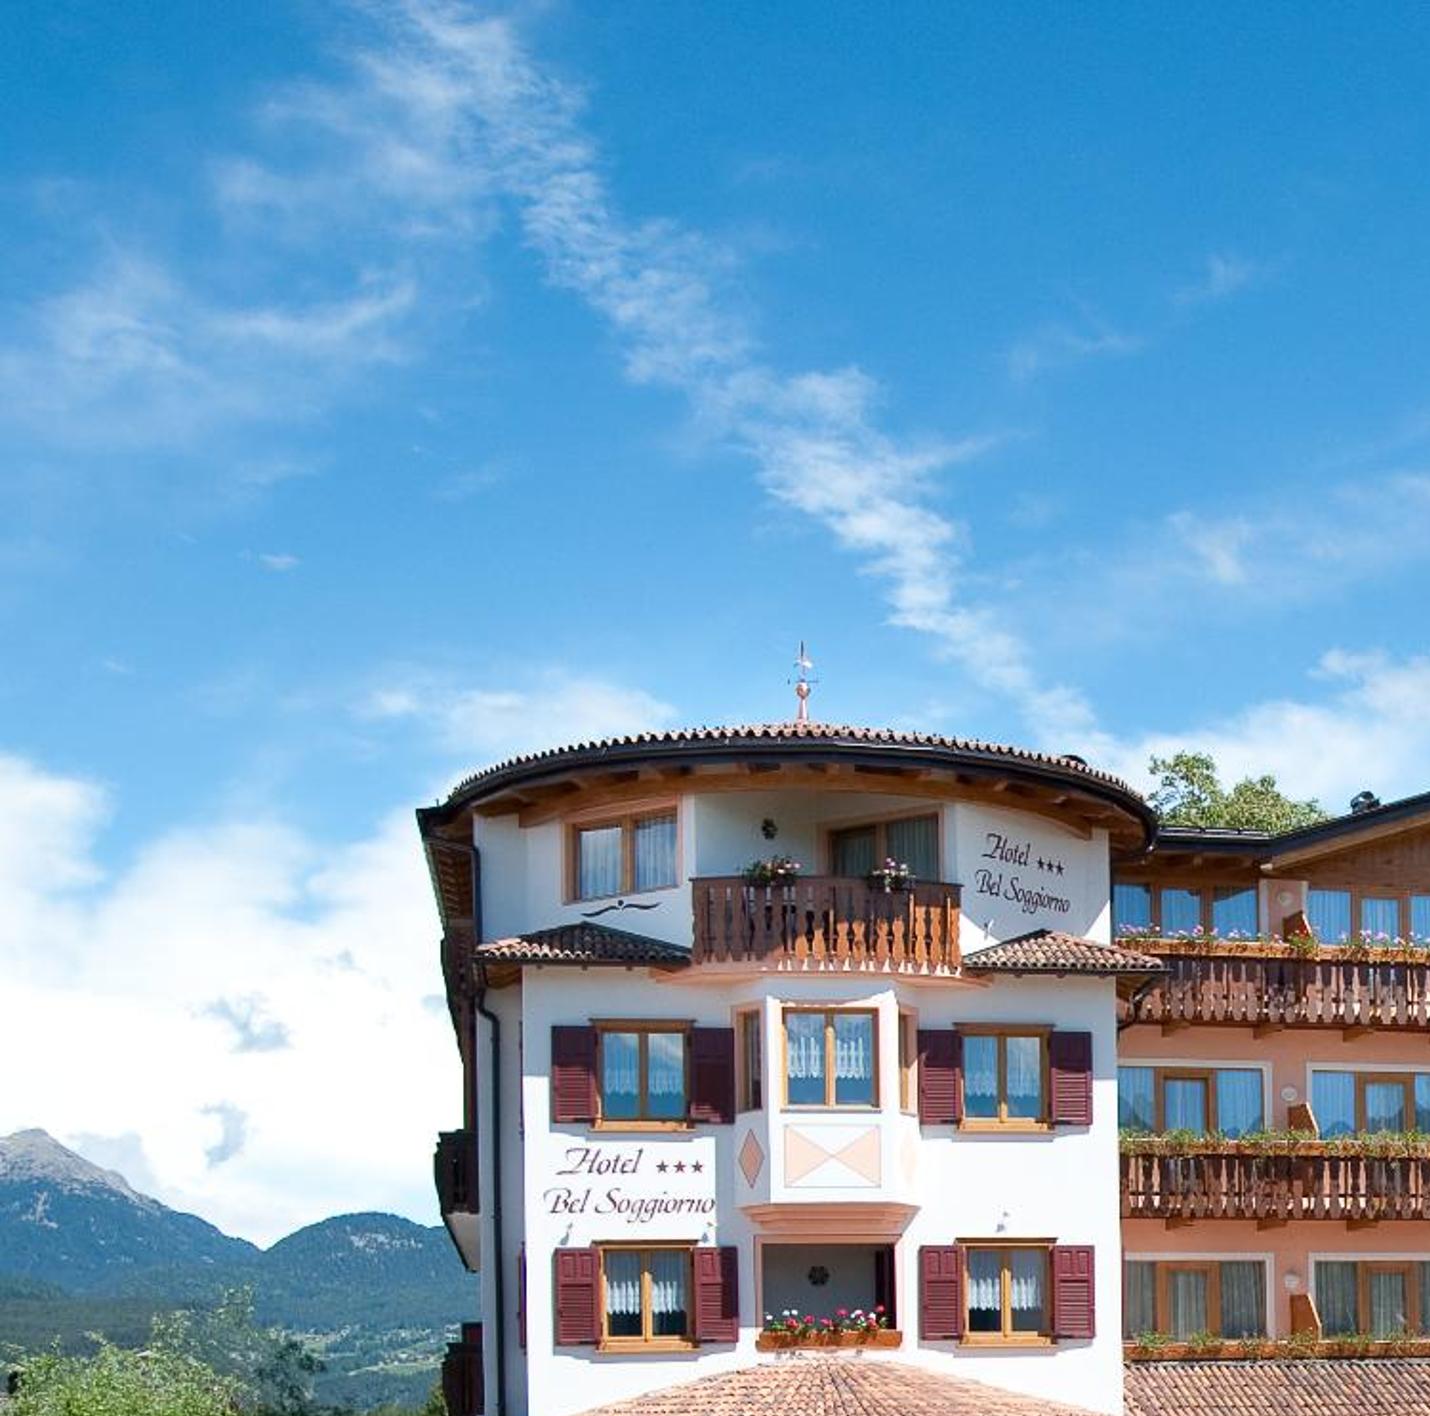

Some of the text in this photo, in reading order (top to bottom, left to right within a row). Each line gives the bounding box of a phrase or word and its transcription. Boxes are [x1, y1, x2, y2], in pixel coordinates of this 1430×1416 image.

[981, 833, 1031, 867] Hotel
[975, 869, 1071, 914] Bel Soggiorno
[555, 1147, 643, 1176] Hotel
[543, 1187, 716, 1223] Bel Soggiorno
